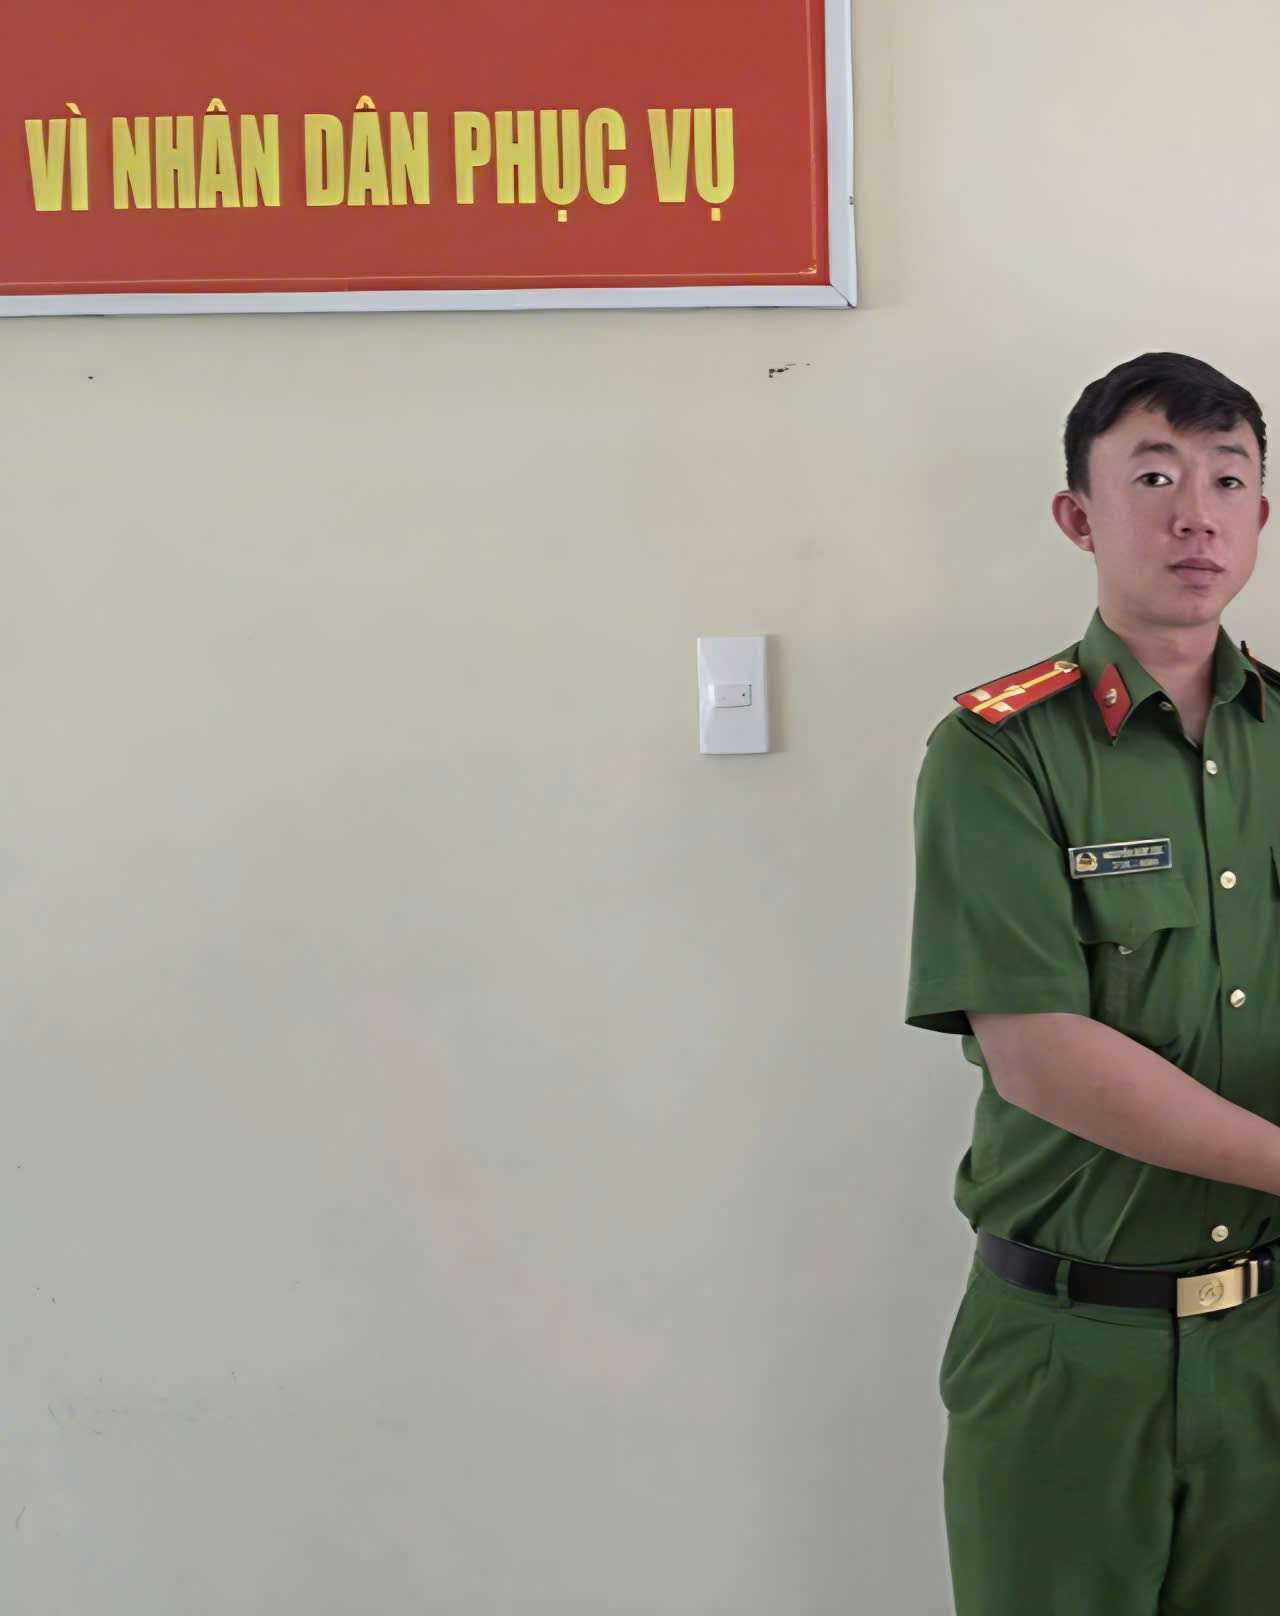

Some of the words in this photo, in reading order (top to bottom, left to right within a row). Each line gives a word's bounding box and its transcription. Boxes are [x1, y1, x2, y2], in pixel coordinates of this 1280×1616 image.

[25, 102, 89, 212] VÌ
[112, 97, 281, 209] NHÂN
[304, 95, 431, 207] DÂN
[454, 107, 627, 222] PHỤC
[648, 107, 736, 222] VỤ
